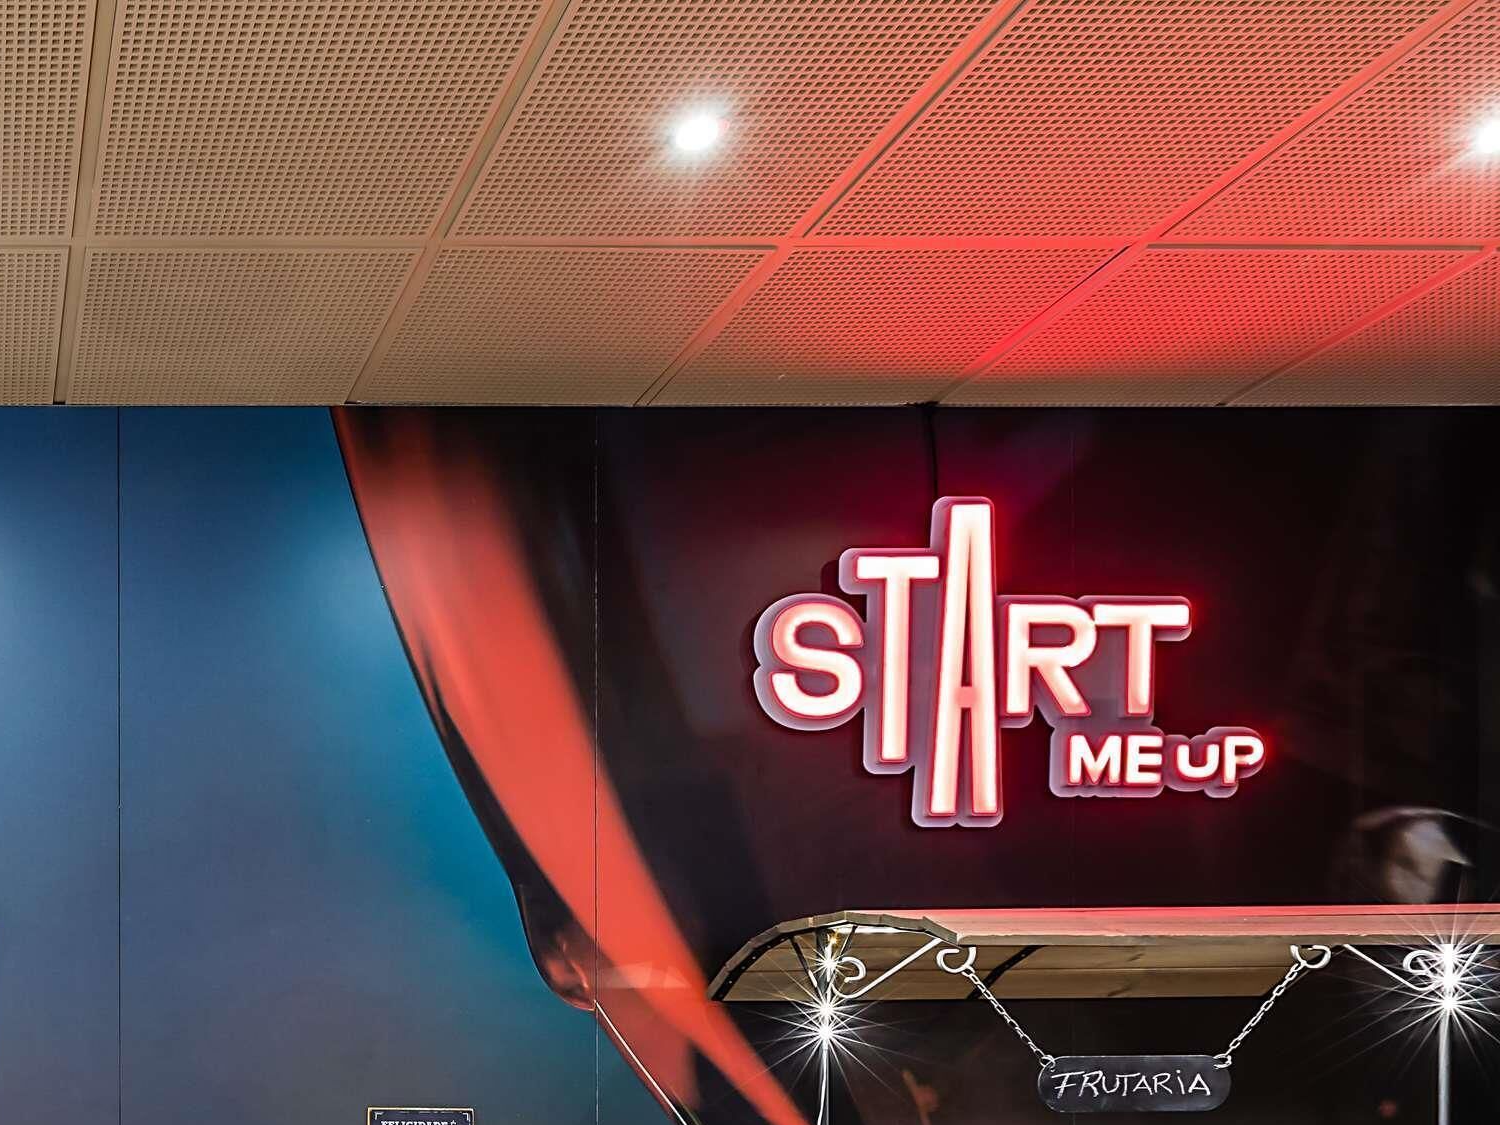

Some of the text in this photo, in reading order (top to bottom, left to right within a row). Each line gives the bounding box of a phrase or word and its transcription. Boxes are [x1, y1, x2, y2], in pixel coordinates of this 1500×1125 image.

[770, 503, 1190, 815] START
[1067, 734, 1265, 787] ME UP
